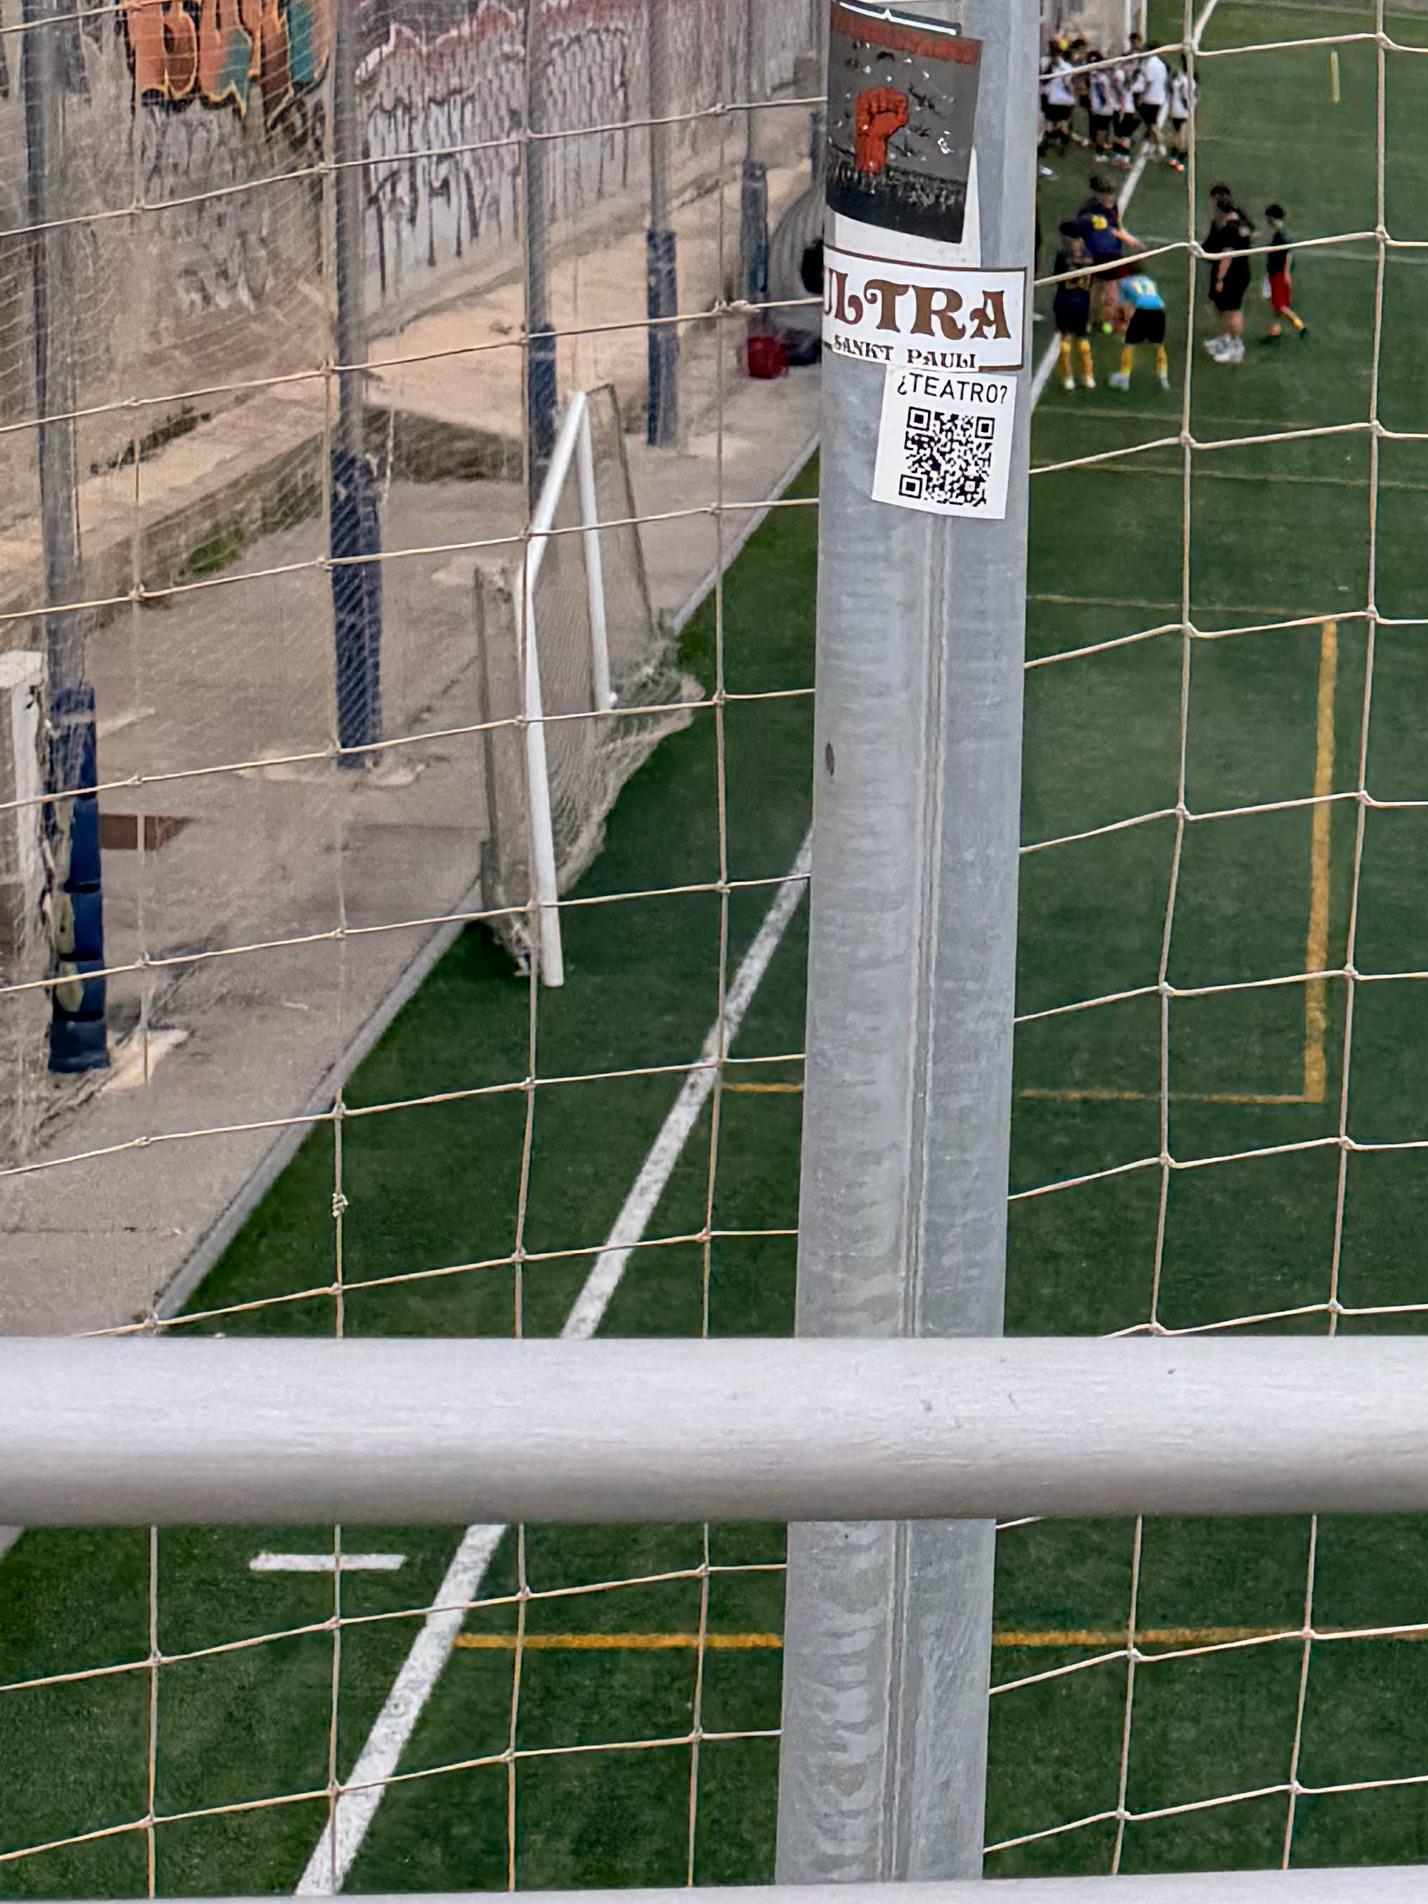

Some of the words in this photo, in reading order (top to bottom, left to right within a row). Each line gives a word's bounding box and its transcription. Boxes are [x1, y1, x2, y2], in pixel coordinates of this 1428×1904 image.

[834, 334, 894, 362] SANKT
[906, 348, 976, 370] PAULI
[896, 372, 1008, 405] ¿TEATRO?
